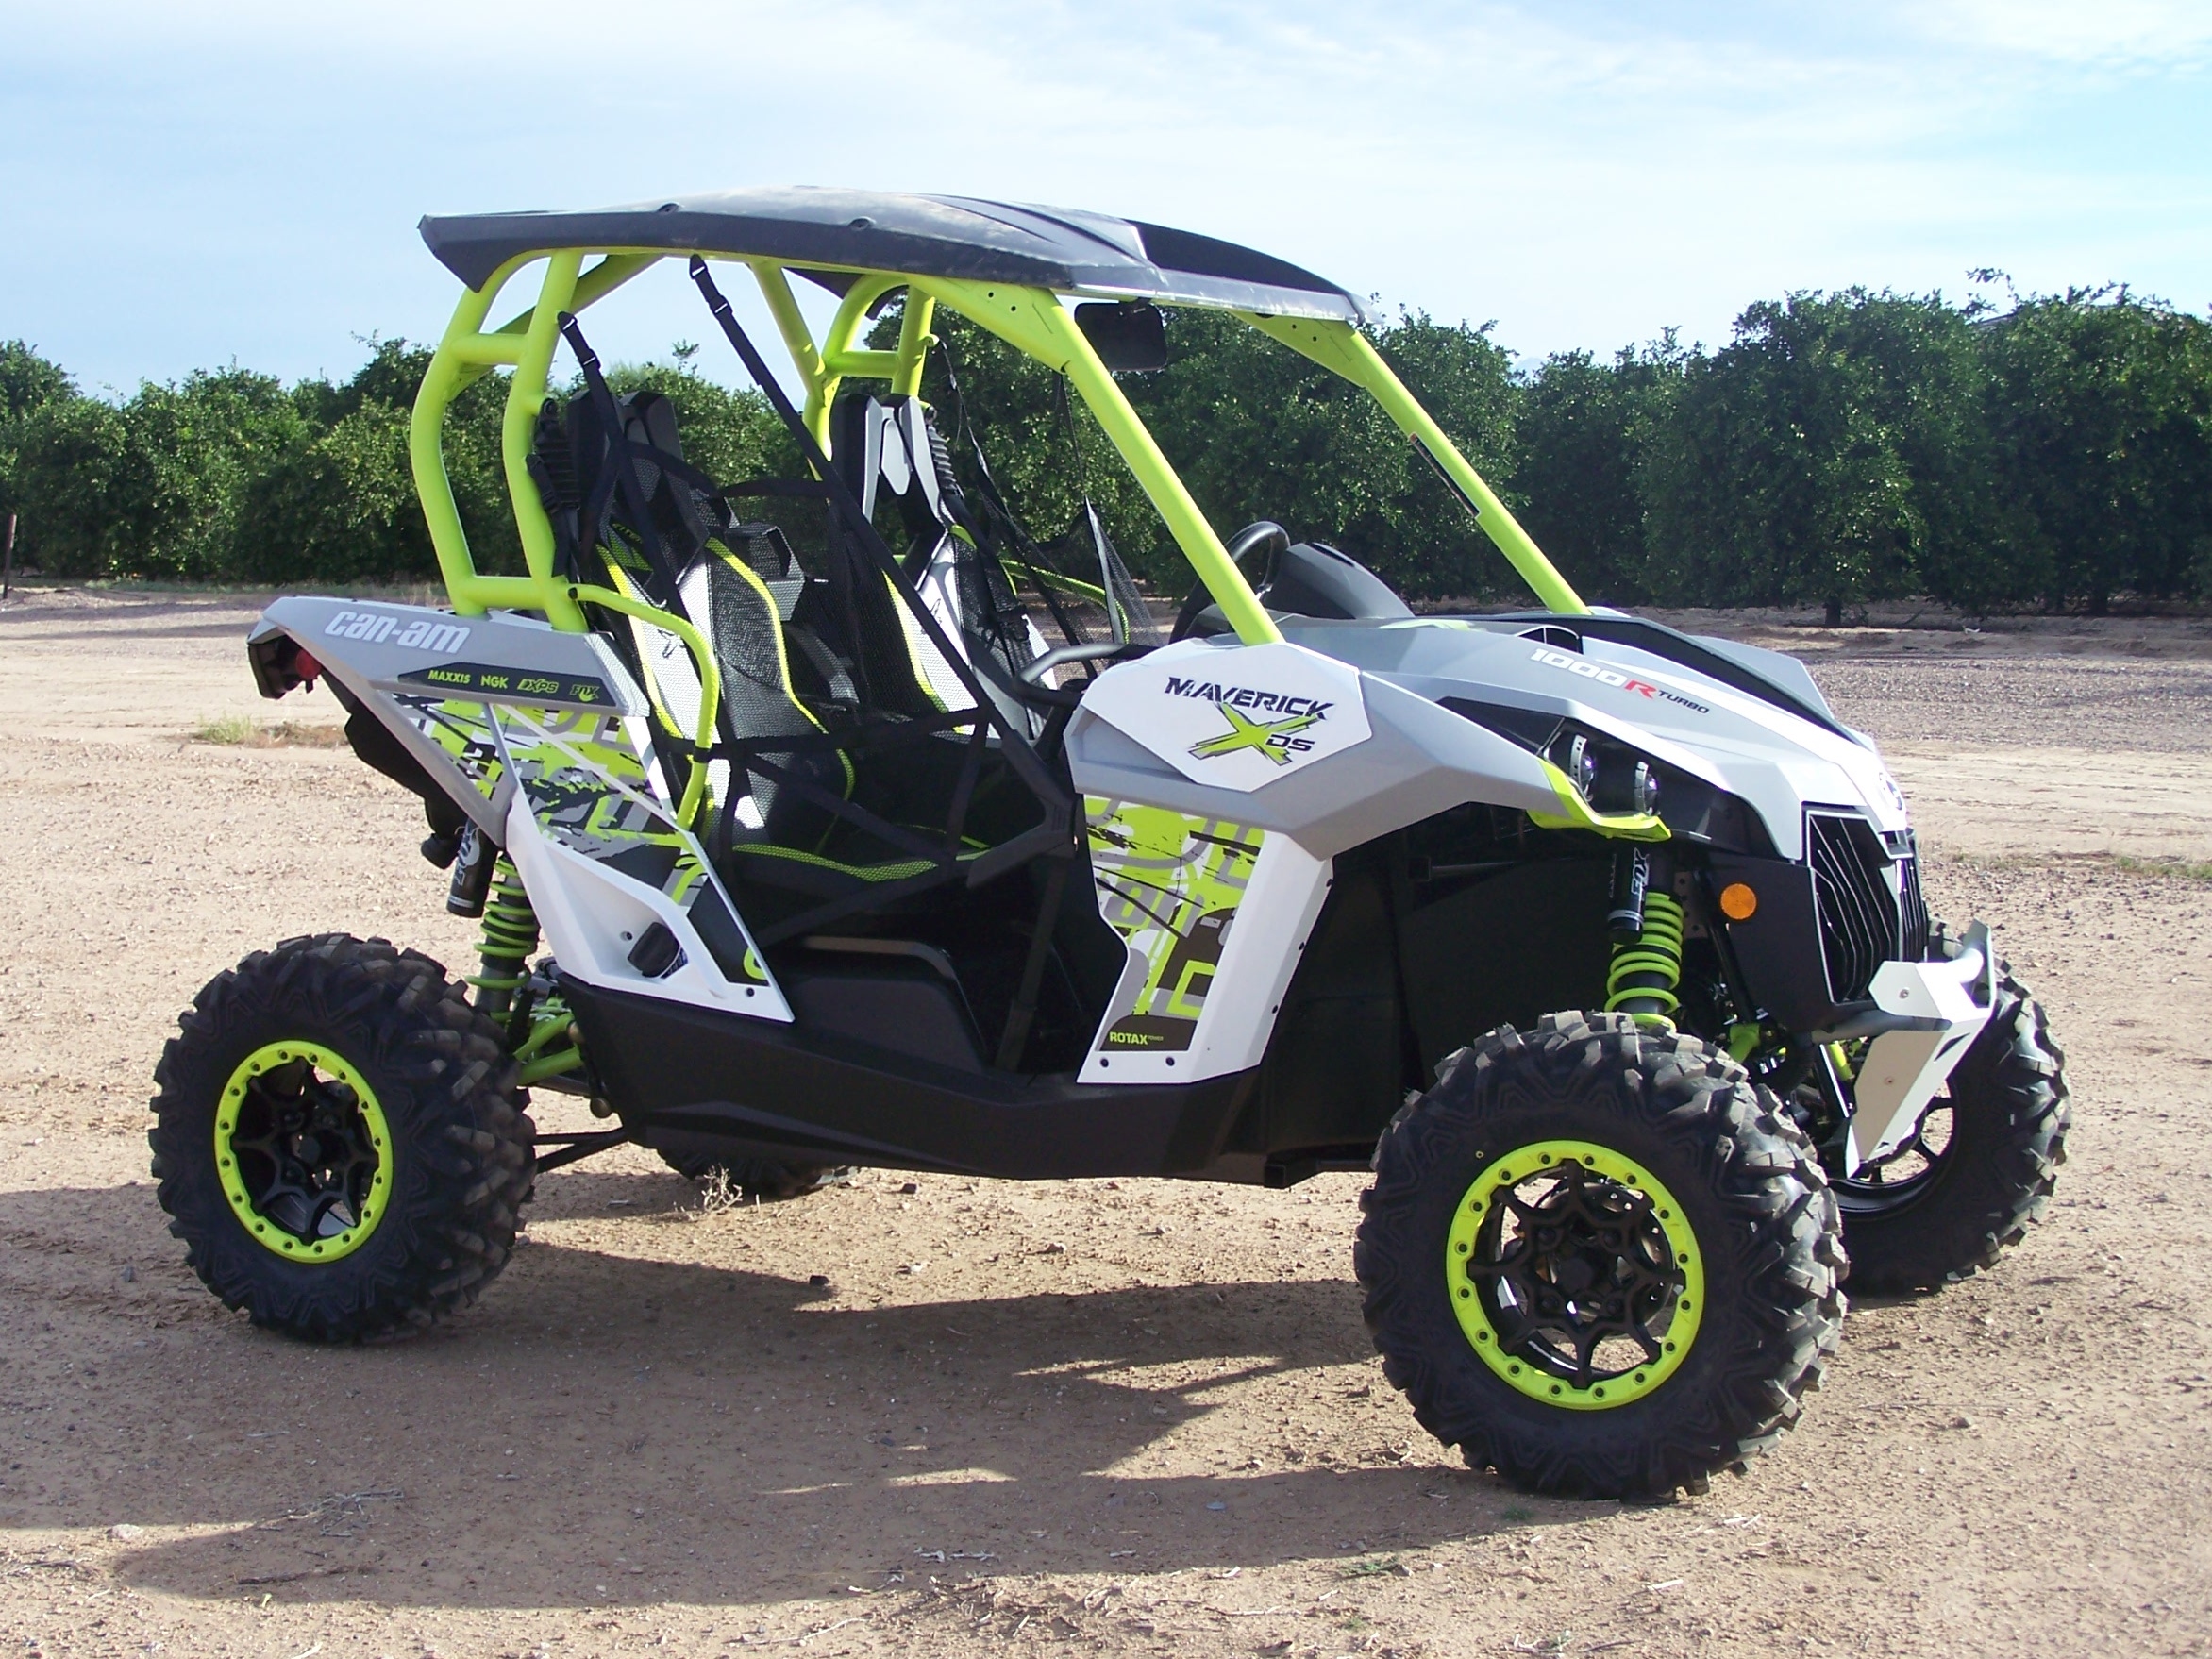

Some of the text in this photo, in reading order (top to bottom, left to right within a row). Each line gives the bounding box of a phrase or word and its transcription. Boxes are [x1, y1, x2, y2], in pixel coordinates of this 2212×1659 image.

[427, 670, 600, 699] MAXXIS NGK XPS FOX
[1165, 677, 1334, 720] MAVERICK
[1531, 648, 1710, 714] 1000R TURBO
[1631, 847, 1650, 895] FOX
[1109, 1031, 1148, 1045] ROTAX
